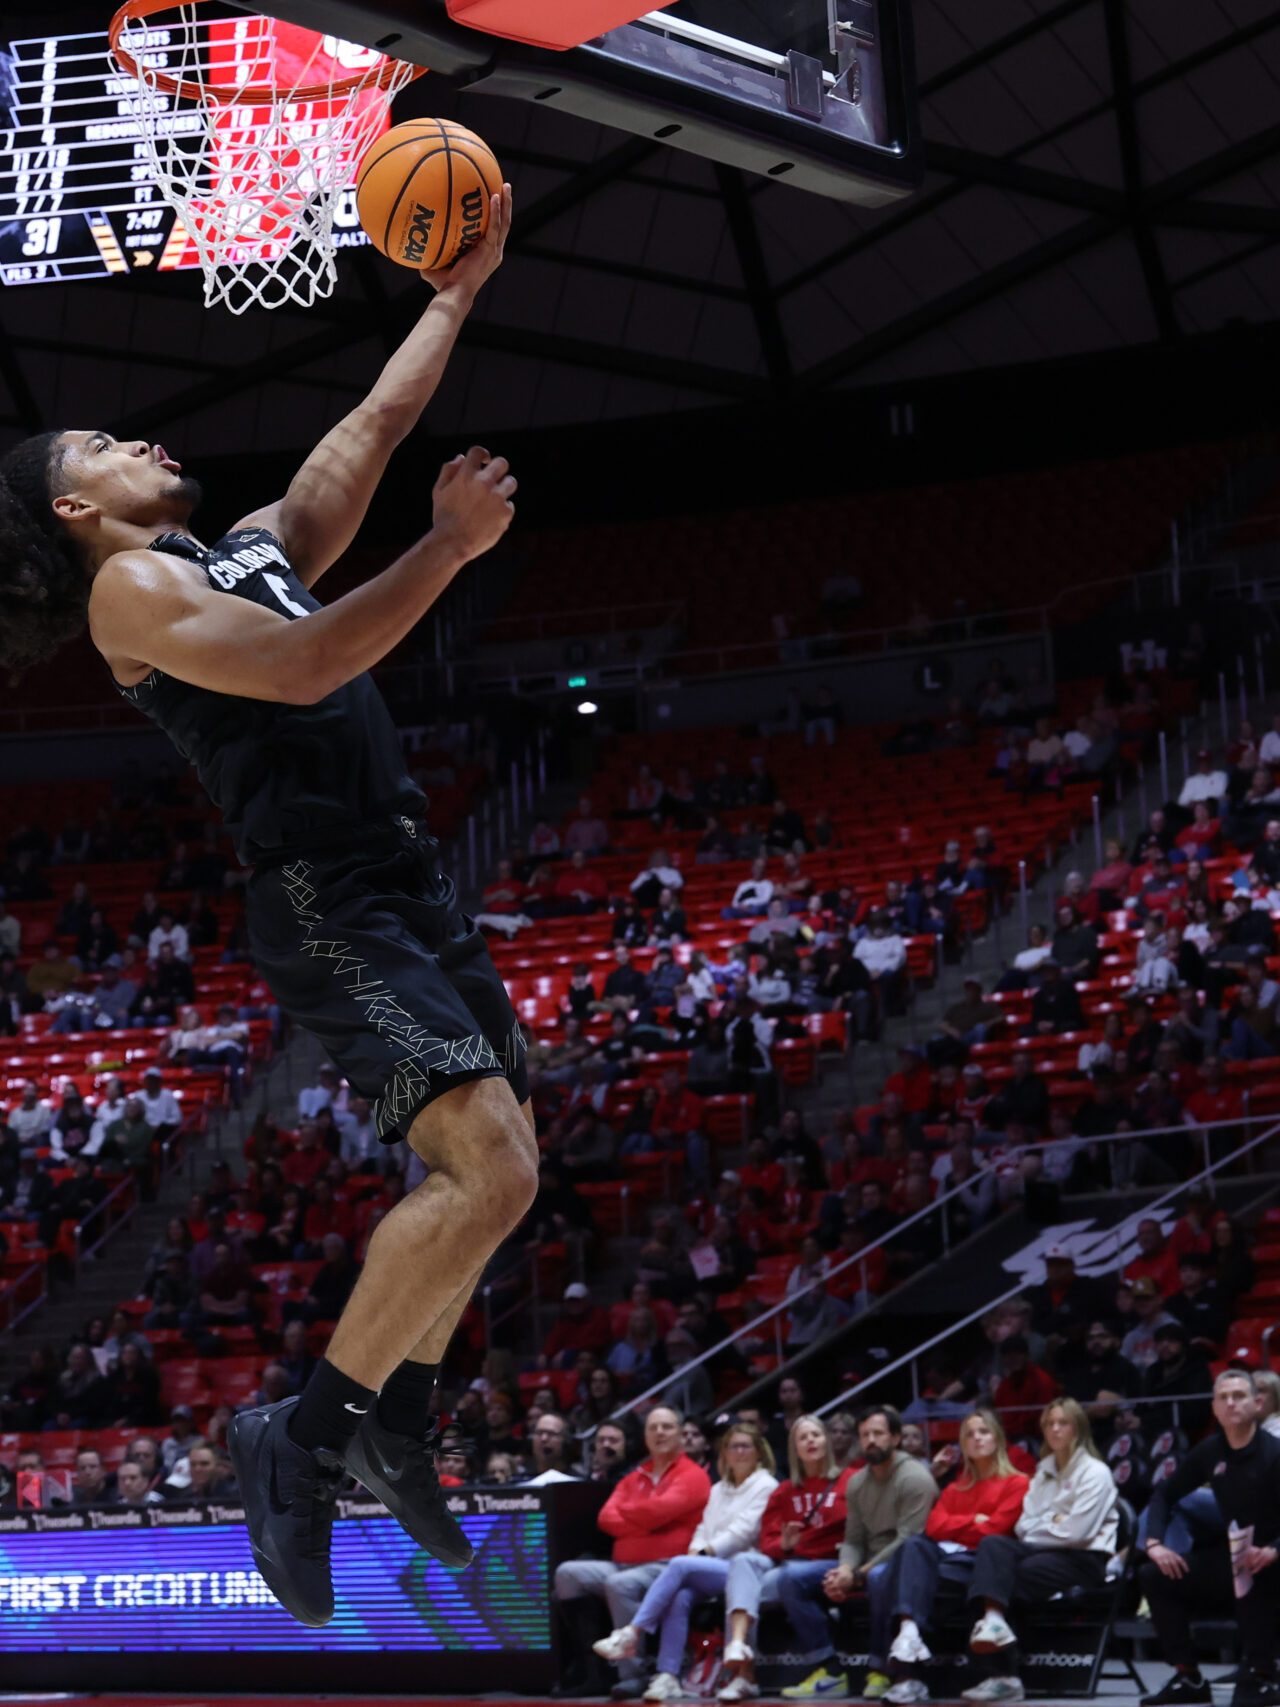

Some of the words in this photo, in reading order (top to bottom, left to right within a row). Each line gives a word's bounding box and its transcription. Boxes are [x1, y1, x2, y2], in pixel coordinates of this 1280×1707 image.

[22, 217, 61, 256] 31
[331, 232, 374, 248] EALT
[402, 202, 436, 262] NCAA
[474, 1493, 541, 1513] Trucordia
[94, 1573, 208, 1606] CREDIT
[209, 1571, 280, 1604] UNI
